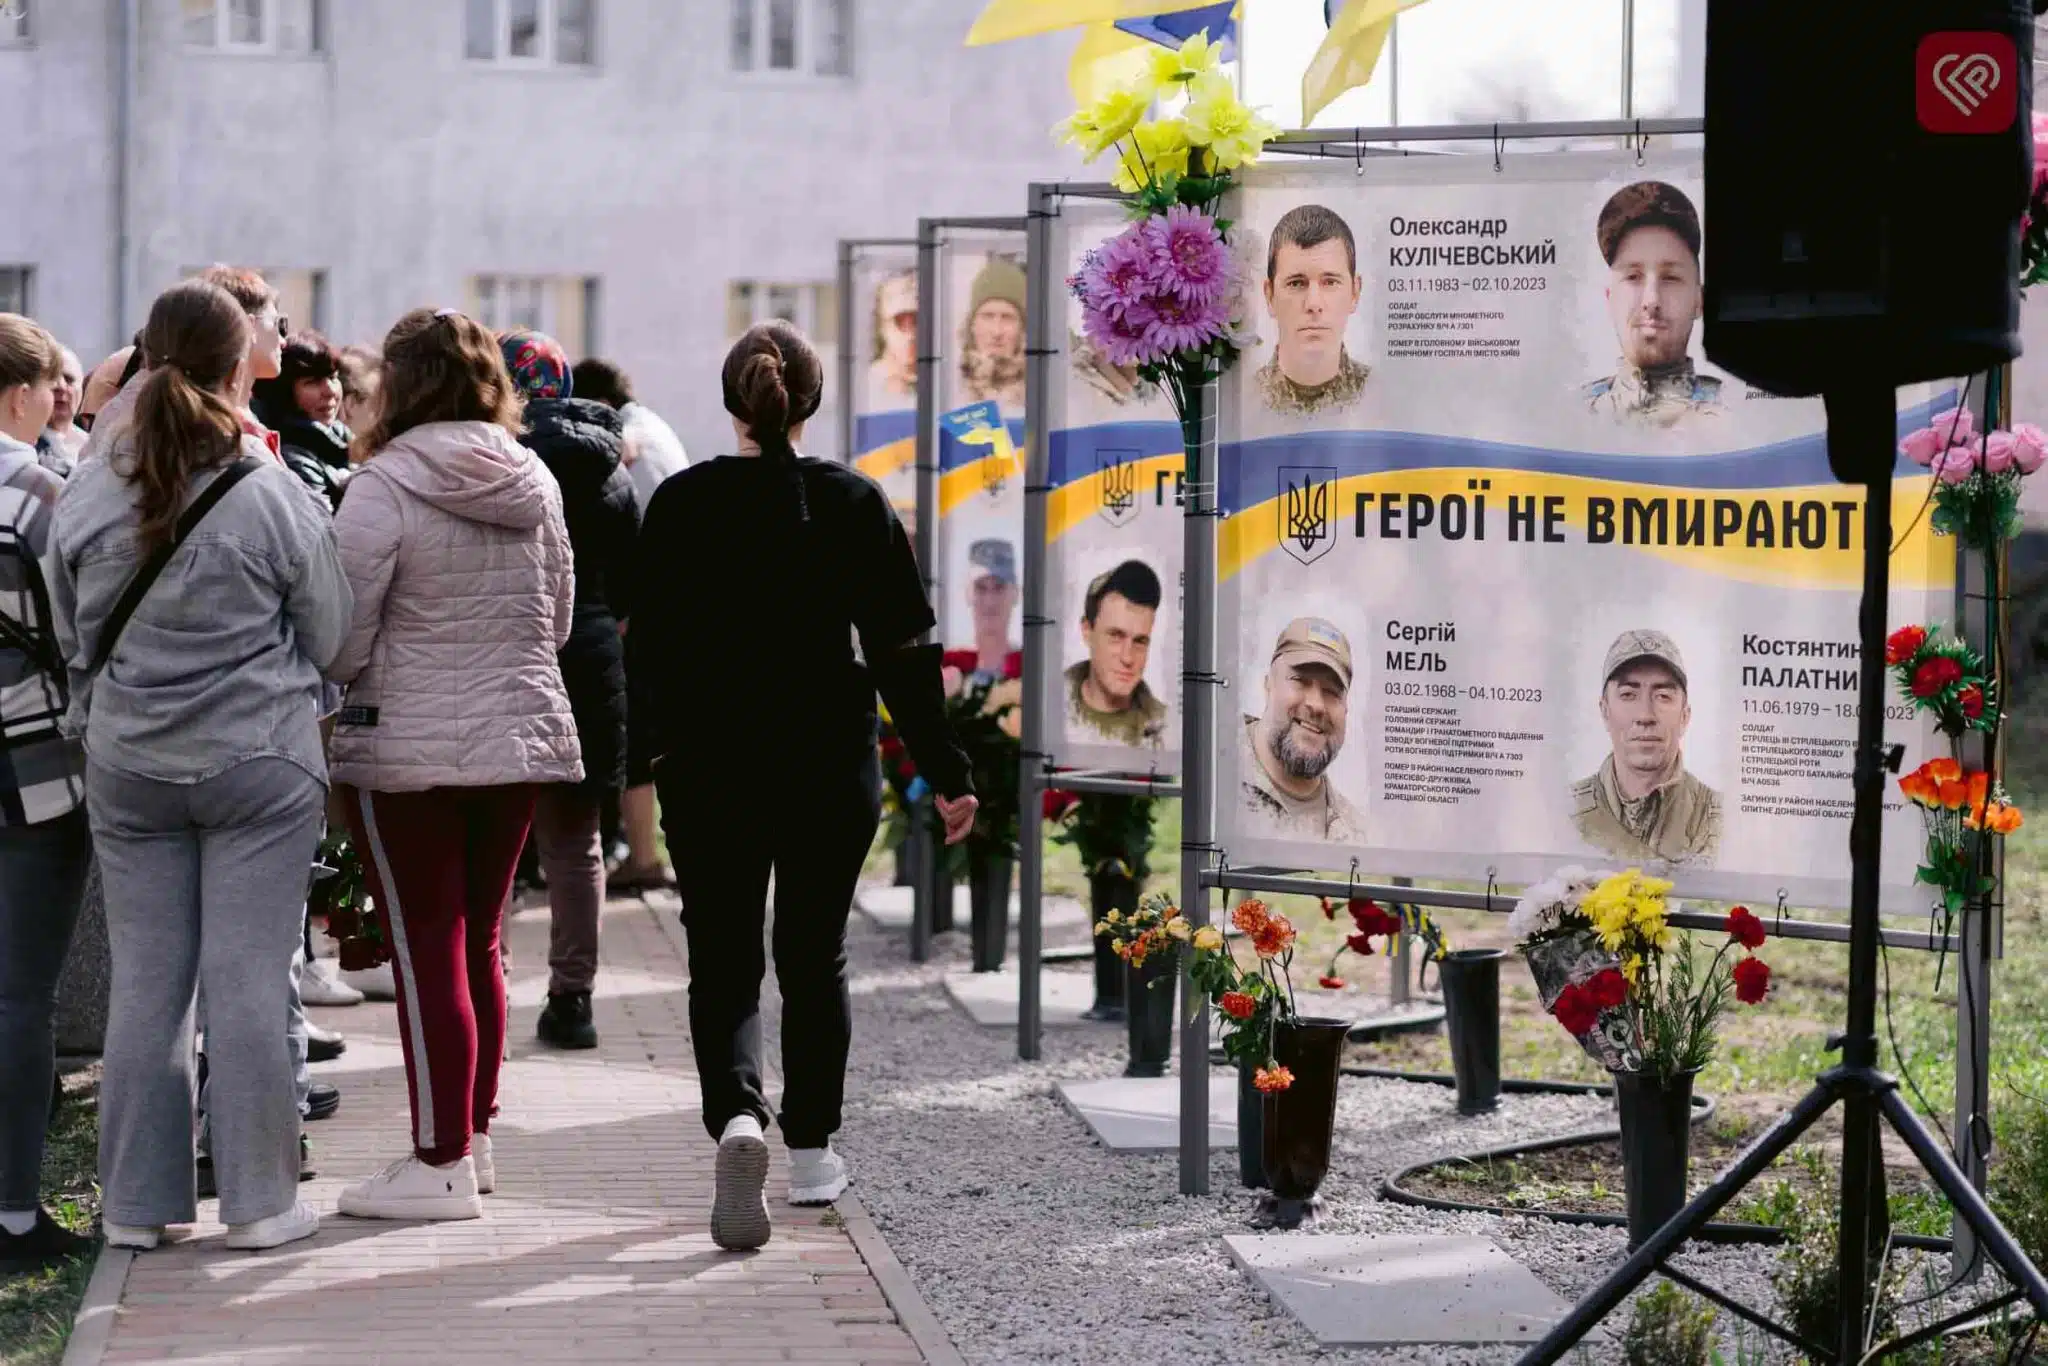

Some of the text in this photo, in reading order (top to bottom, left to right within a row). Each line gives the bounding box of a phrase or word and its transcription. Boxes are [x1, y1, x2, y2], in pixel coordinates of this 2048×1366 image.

[1390, 217, 1507, 238] Олександр
[1390, 239, 1556, 266] КУЛІЧЕВСЬКИЙ
[1421, 339, 1466, 347] ГОЛОВНОМУ
[1468, 339, 1520, 347] ВІЙСЬКОВОМУ
[1355, 479, 1880, 550] ГЕРОЇ НЕ ВМИРАЮТ
[1387, 621, 1456, 645] Сергій
[1743, 634, 1863, 659] Костянтин
[1386, 651, 1447, 672] МЕЛЬ
[1385, 706, 1420, 715] СТАРШИЙ
[1385, 716, 1424, 724] ГОЛОВНИЙ
[1385, 726, 1425, 735] КОМАНДИР
[1431, 728, 1497, 739] ГРАНАТОМЕТНОГО
[1499, 732, 1543, 741] ВІДДІЛЕННЯ
[1743, 724, 1775, 732] СОЛДАТ
[1385, 737, 1494, 749] ВЗВОДУ ВОГНЕВОЇ ПІДТРИМКИ
[1743, 735, 1780, 744] СТРІЛЕЦЬ
[1791, 738, 1850, 747] СТРІЛЕЦЬКОГО
[1385, 746, 1403, 754] РОТИ
[1405, 747, 1440, 756] ВОГНЕВОЇ
[1442, 750, 1484, 759] ПІДТРИМКИ
[1751, 747, 1809, 757] СТРІЛЕЦЬКОГО
[1812, 749, 1844, 758] ВЗВОДУ
[1747, 757, 1798, 766] СТРІЛЕЦЬКОЇ
[1800, 759, 1820, 767] РОТИ
[1385, 762, 1409, 770] ПОМЕР
[1418, 764, 1443, 773] РАЙОНІ
[1446, 766, 1493, 776] НАСЕЛЕНОГО
[1495, 769, 1523, 778] ПУНКТУ
[1747, 767, 1805, 777] СТРІЛЕЦЬКОГО
[1807, 770, 1854, 779] БАТАЛЬЙОН
[1742, 777, 1755, 785] В/Ч
[1385, 783, 1481, 795] КРАМАТОРСЬКОГО РАЙОНУ
[1384, 793, 1459, 804] ДОНЕЦЬКОЇ ОБЛАСТІ
[1742, 794, 1777, 804] ЗАГИНУВ
[1785, 796, 1814, 806] РАЙОНІ
[1741, 805, 1855, 819] ОПИТНЕ ДОНЕЦЬКОЇ ОБЛАСТ
